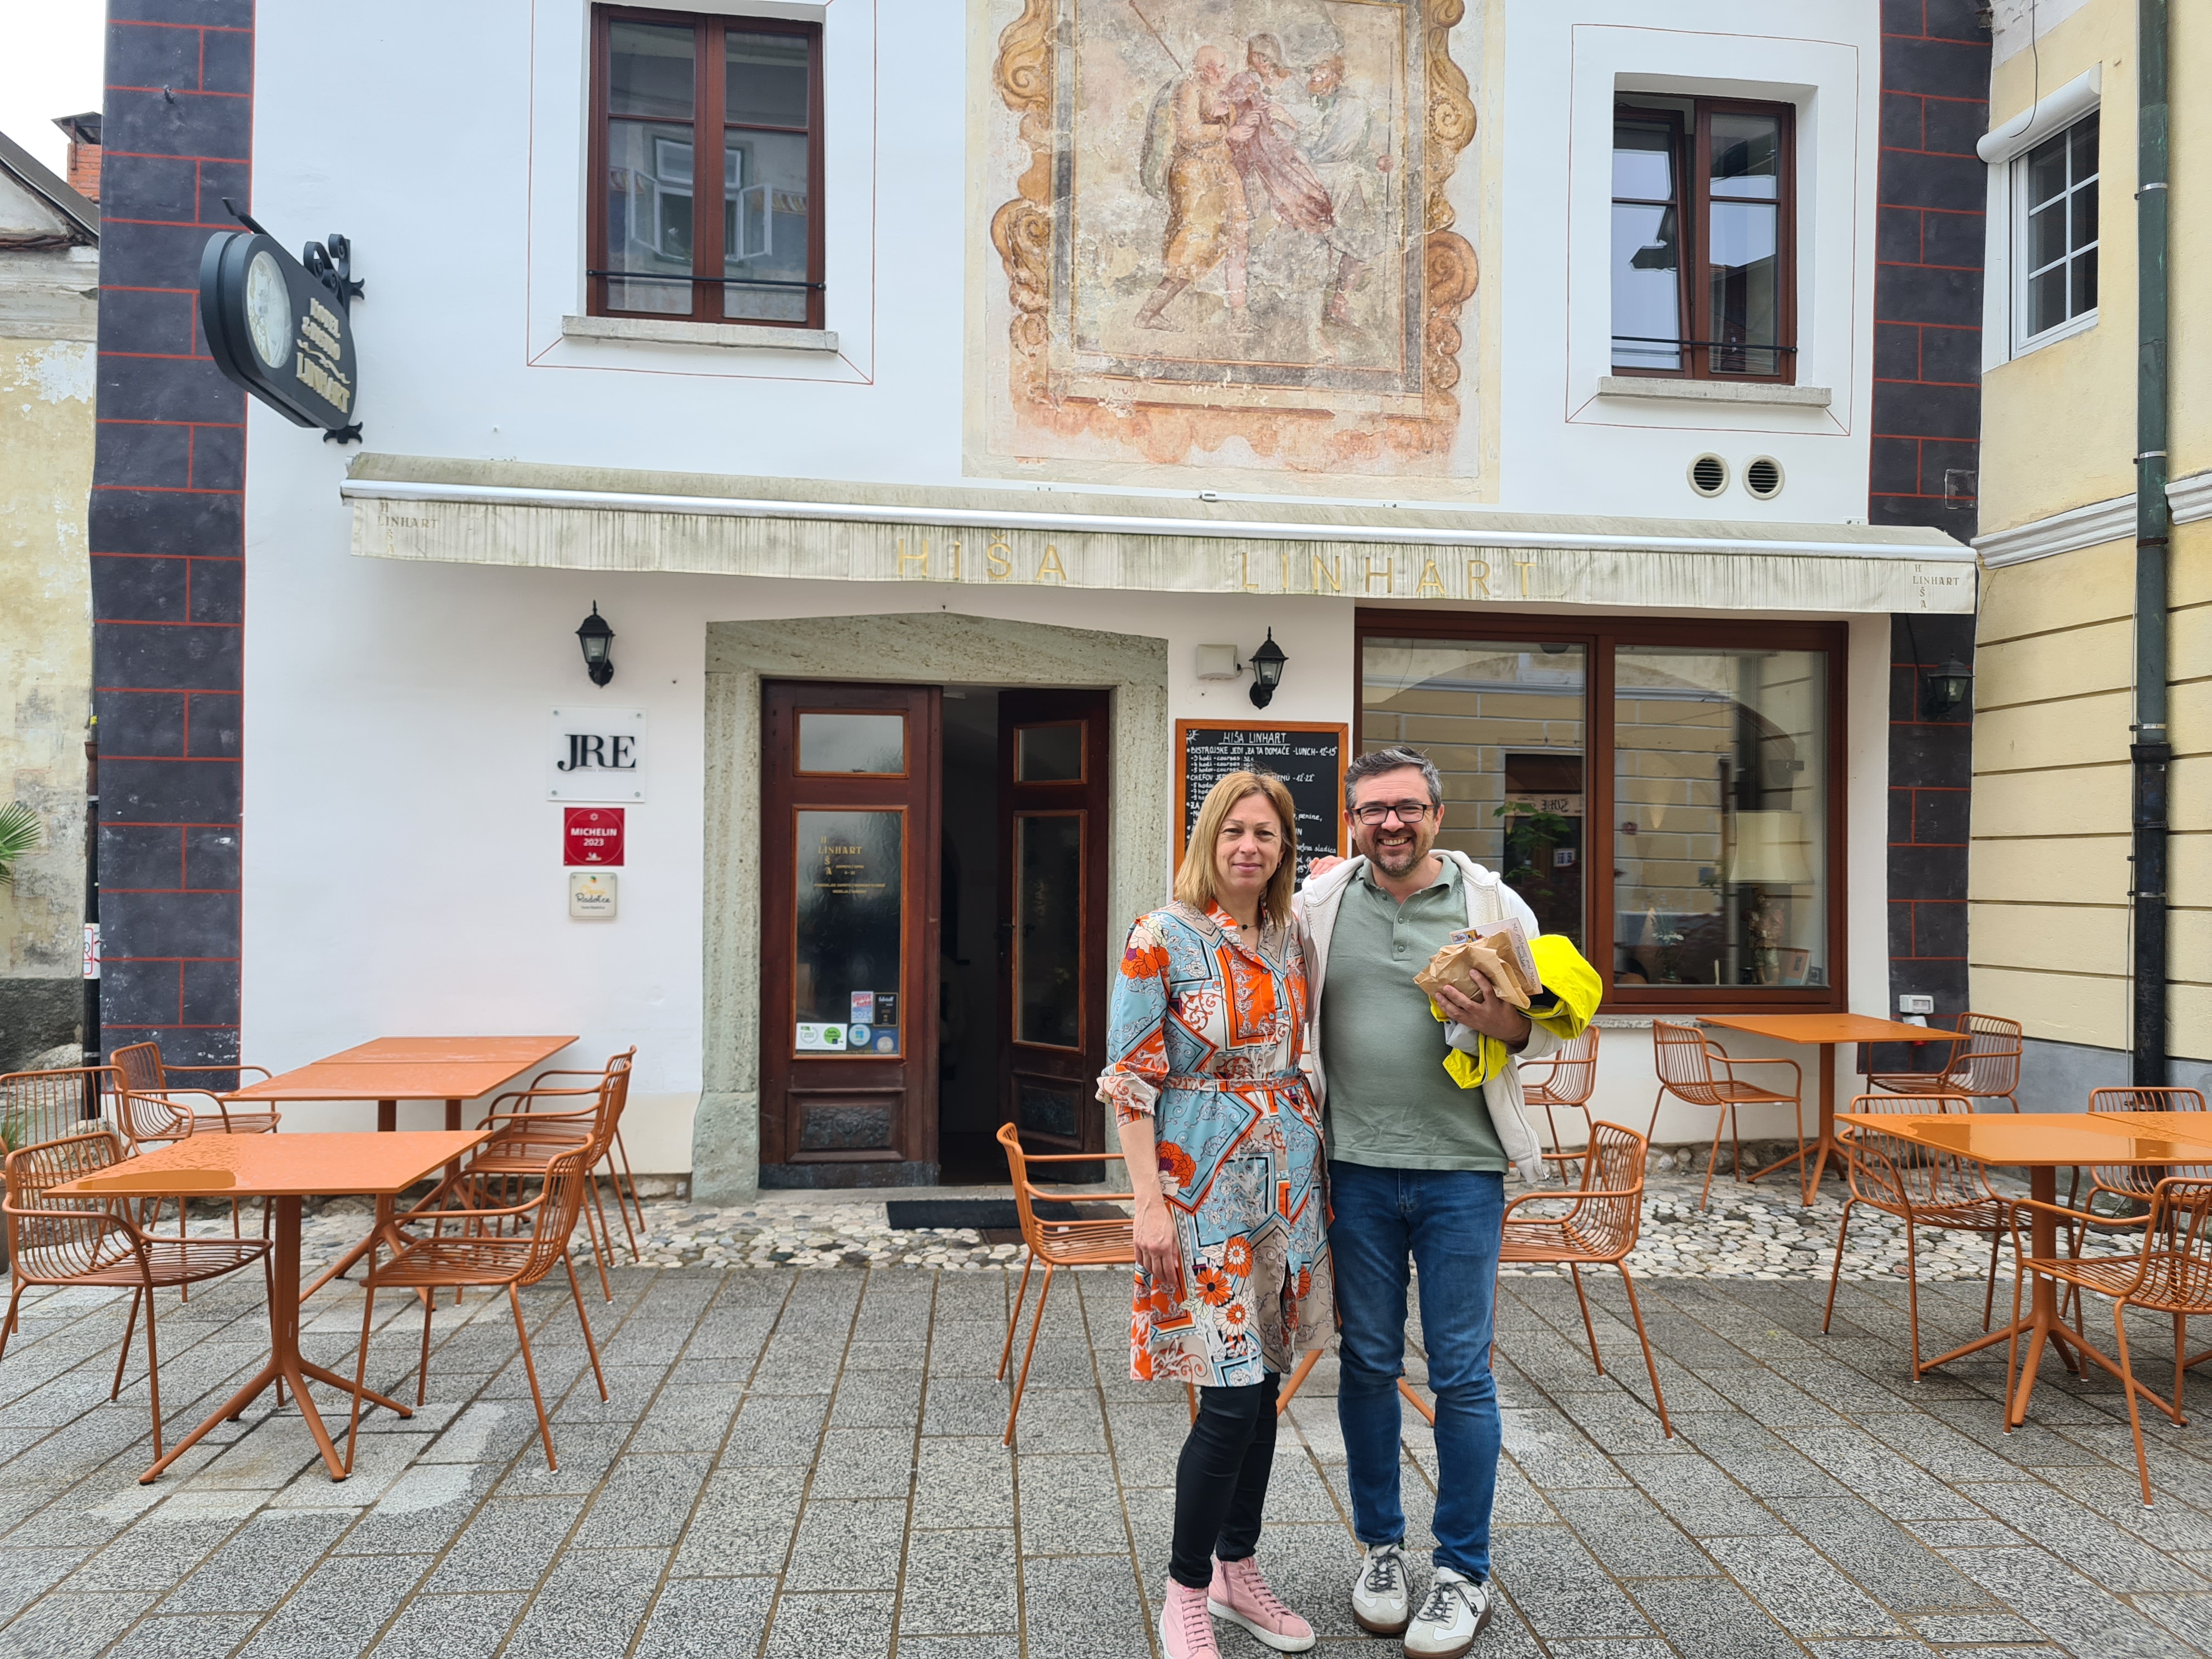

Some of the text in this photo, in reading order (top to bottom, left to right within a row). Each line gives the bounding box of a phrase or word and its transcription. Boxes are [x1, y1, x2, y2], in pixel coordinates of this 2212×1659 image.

[296, 352, 350, 414] LINHART
[377, 516, 439, 528] LINHART
[898, 532, 1536, 596] HIŠA LINHART
[1913, 575, 1959, 586] LINHART
[1223, 731, 1286, 744] HIŠA LINHART
[557, 734, 636, 771] JRE
[1190, 746, 1228, 754] BISTROJSKE
[1265, 746, 1290, 755] DOMAČE
[571, 827, 617, 837] MICHELIN
[583, 838, 605, 847] 2023
[818, 846, 862, 854] LINHART
